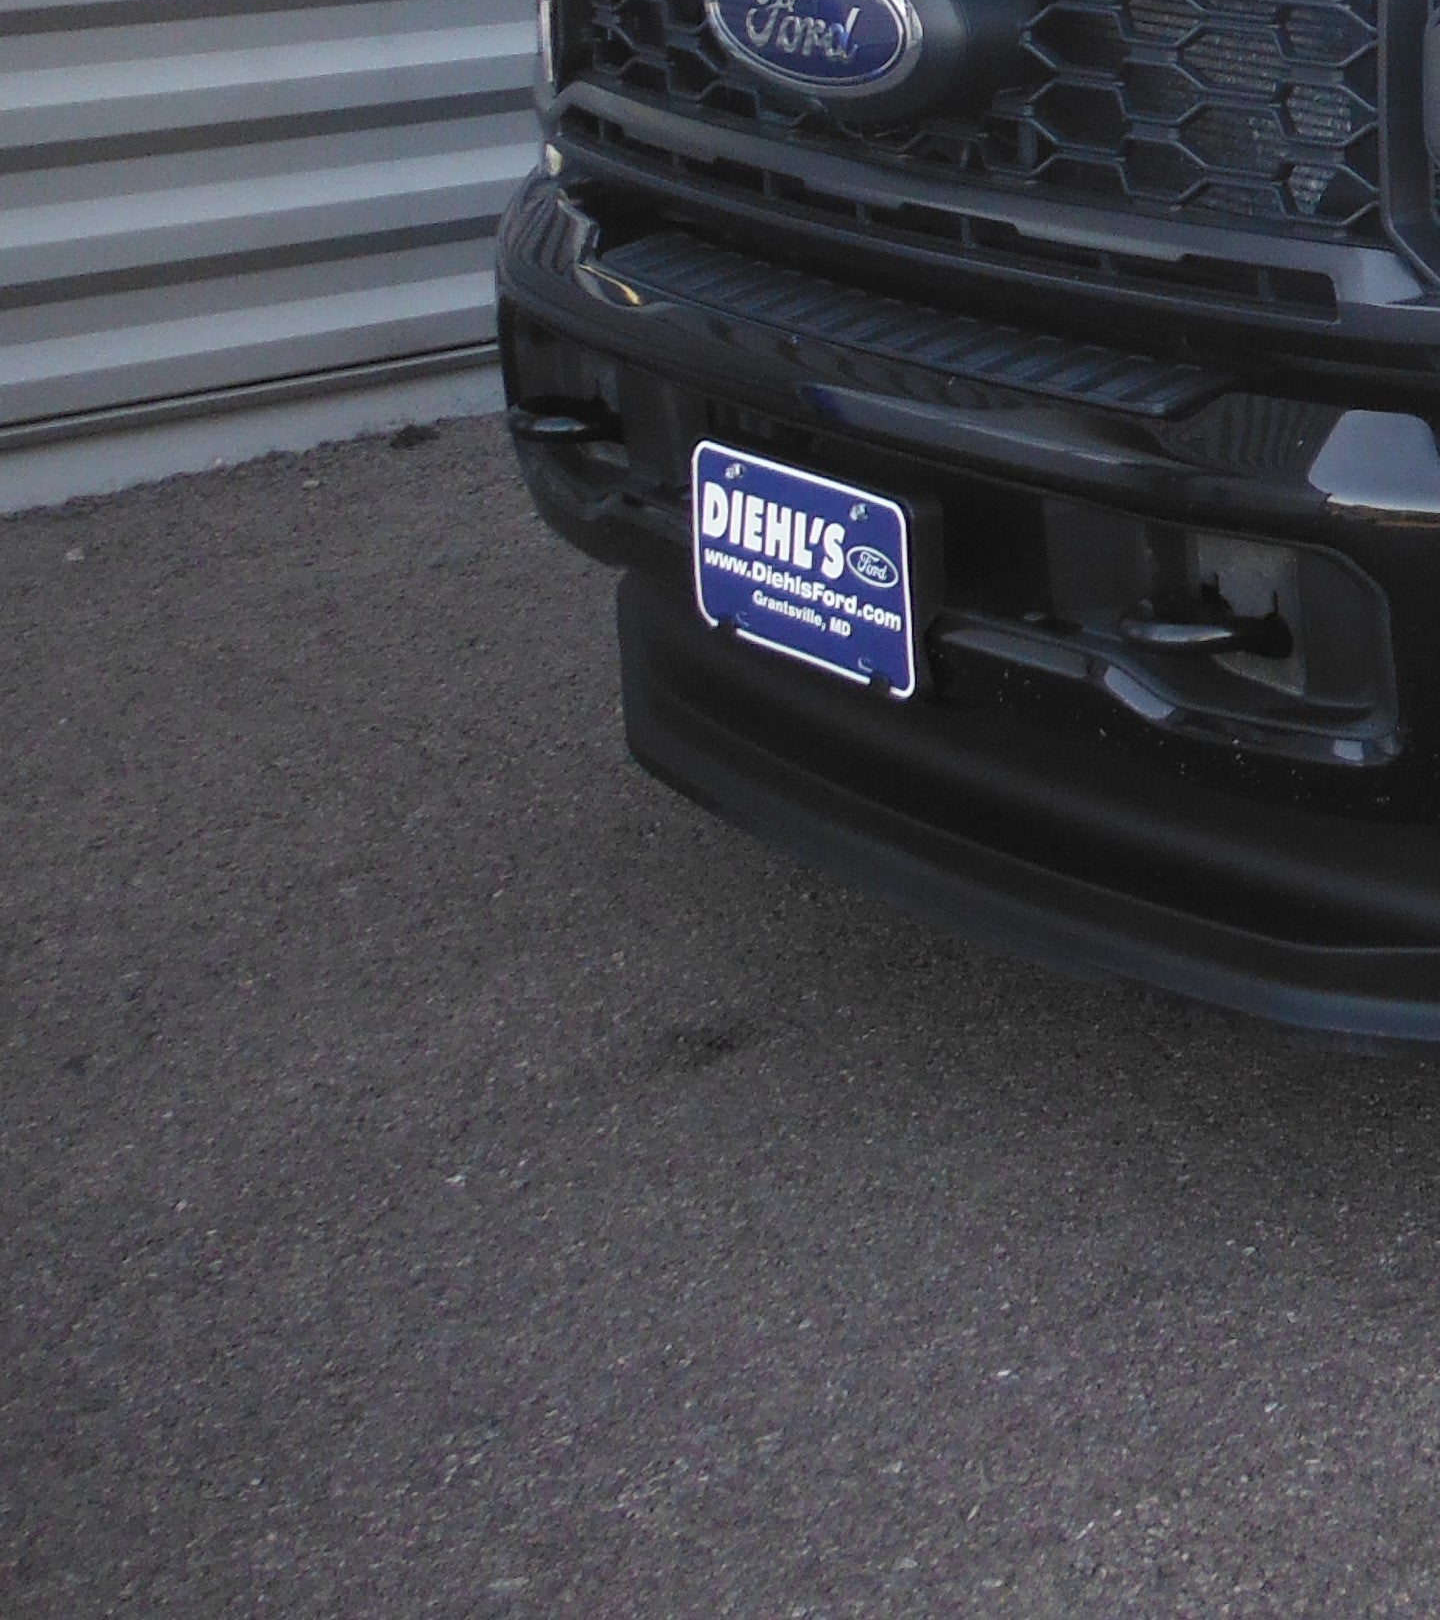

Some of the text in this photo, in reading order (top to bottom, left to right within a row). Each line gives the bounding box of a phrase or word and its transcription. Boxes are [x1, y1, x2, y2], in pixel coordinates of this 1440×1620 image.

[702, 481, 846, 580] DIEHL'S
[703, 547, 903, 632] www.DiehlsFord.com
[855, 550, 889, 582] Ford
[752, 589, 851, 638] Grantsville, MD
